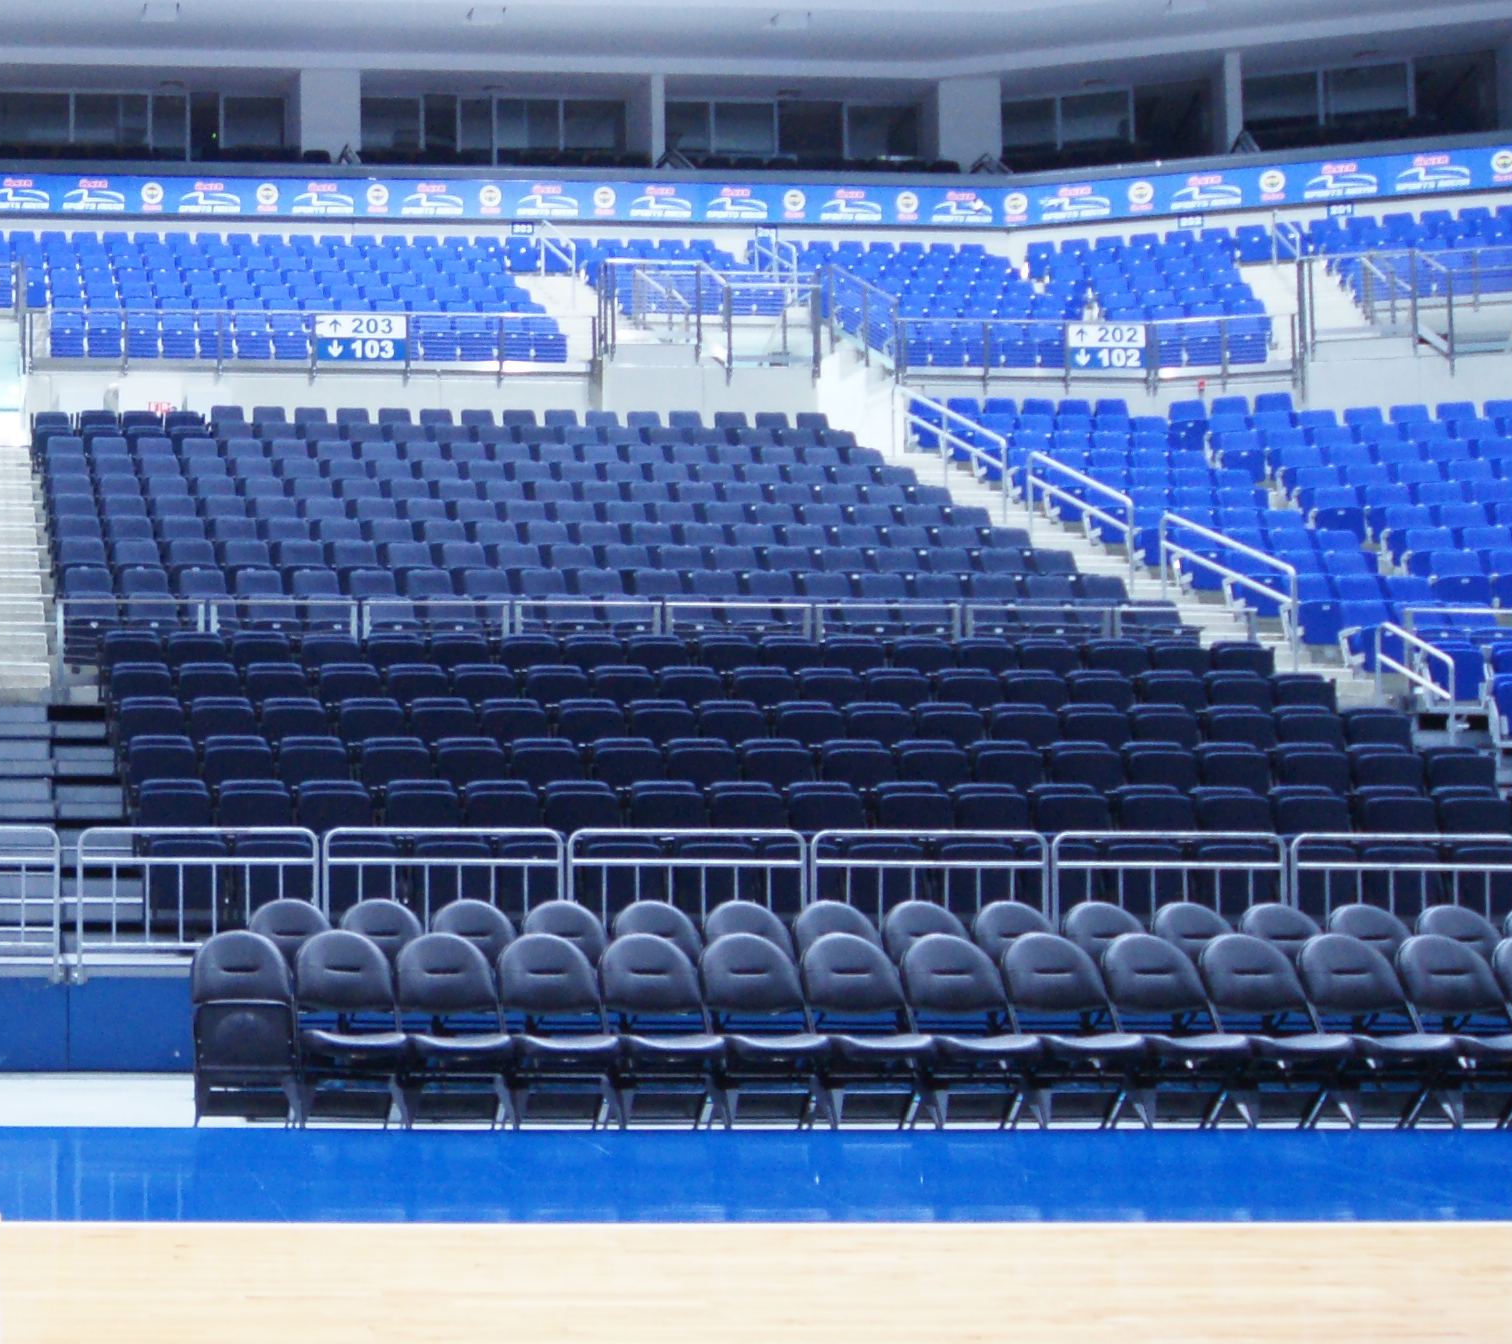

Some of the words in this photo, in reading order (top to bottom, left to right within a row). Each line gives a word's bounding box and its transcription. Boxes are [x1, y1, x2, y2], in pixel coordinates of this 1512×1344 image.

[351, 318, 393, 334] 203
[1097, 327, 1138, 342] 202
[351, 339, 394, 358] 103
[1097, 348, 1141, 367] 102
